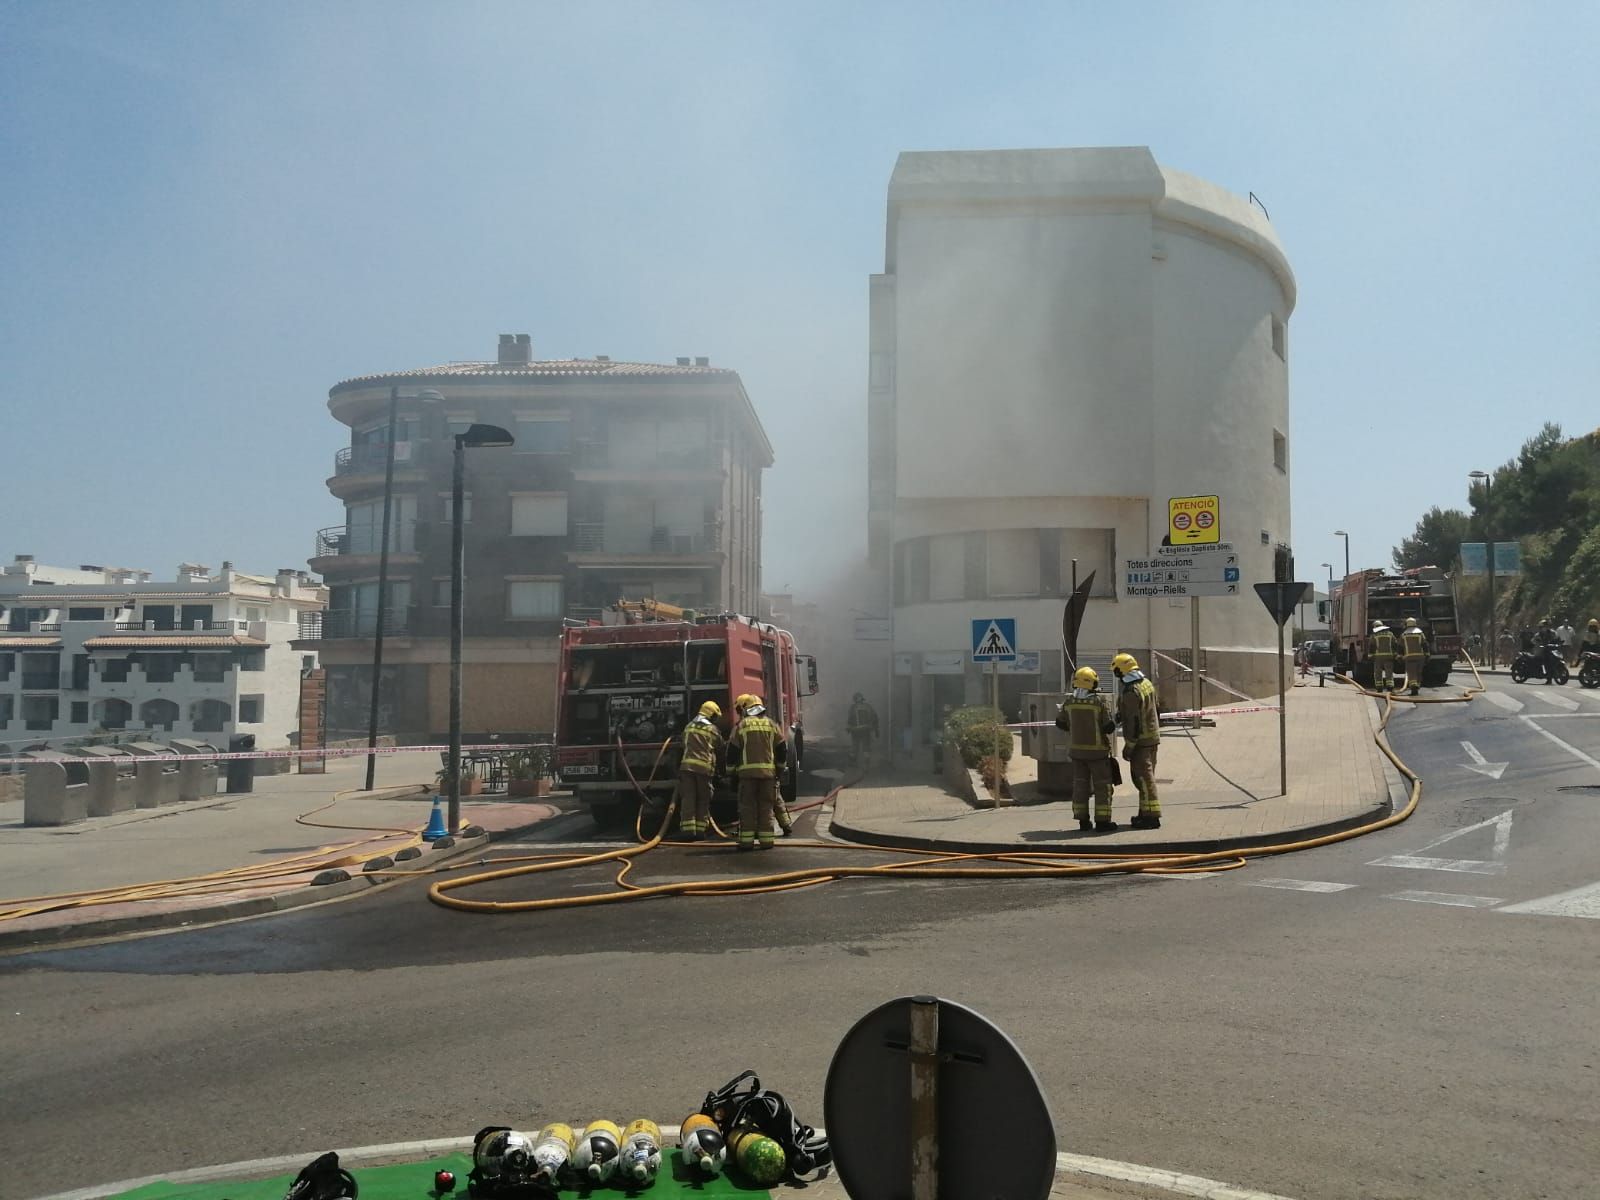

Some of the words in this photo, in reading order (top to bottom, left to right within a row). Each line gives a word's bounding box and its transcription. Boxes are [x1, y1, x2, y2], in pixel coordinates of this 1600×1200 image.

[1173, 498, 1214, 510] ATENCIÓ
[1127, 559, 1149, 569] Totes
[1150, 558, 1193, 568] direccions
